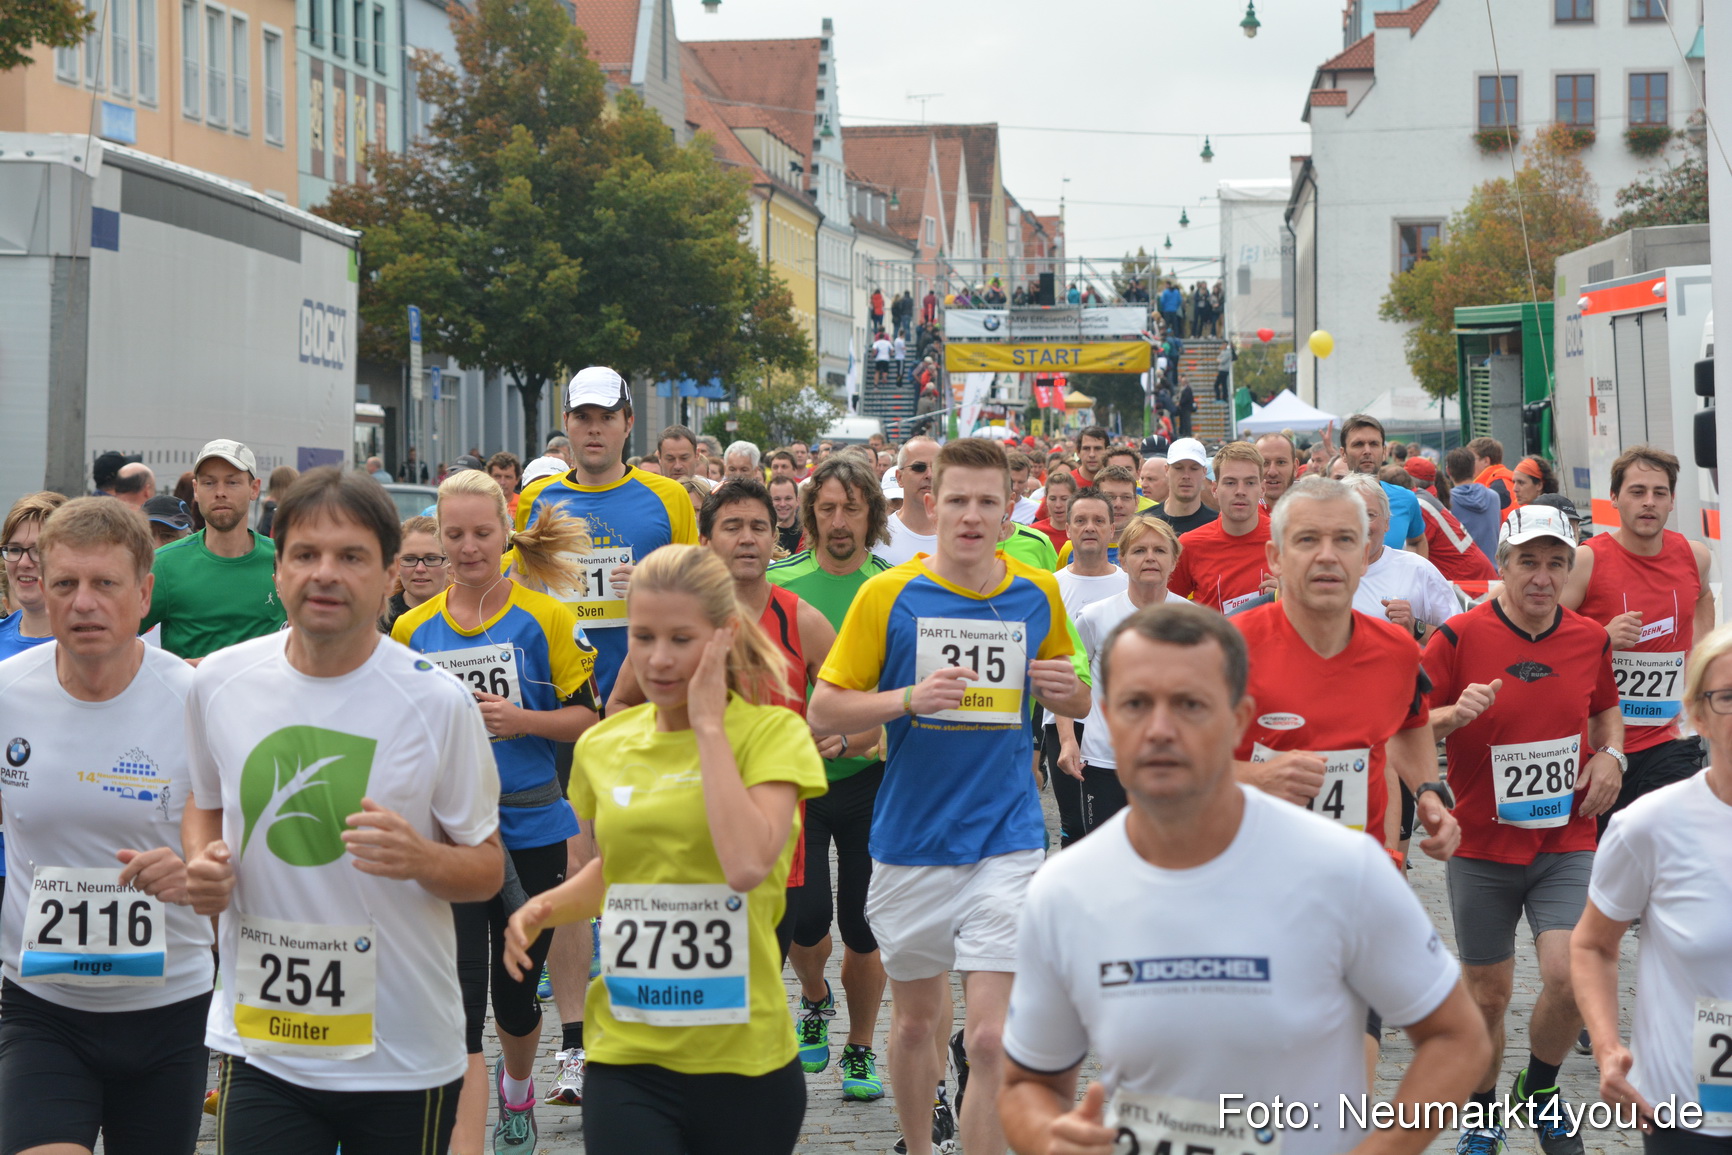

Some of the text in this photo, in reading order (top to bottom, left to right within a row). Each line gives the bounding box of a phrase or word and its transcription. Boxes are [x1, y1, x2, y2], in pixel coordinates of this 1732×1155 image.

[1030, 314, 1109, 324] EfficientDyamics
[299, 299, 346, 370] BOCK
[1012, 348, 1083, 366] START
[577, 605, 604, 617] Sven
[920, 628, 1008, 641] PARTL Neumarkt
[1641, 625, 1662, 637] DEHN
[450, 655, 496, 669] Neumarkt
[941, 644, 1005, 683] 315
[1612, 658, 1673, 667] ARTL Neumarkt
[1613, 669, 1678, 698] 2227
[1623, 703, 1662, 715] Florian
[1494, 747, 1570, 763] PARTL Neumarkt
[1, 767, 30, 781] PARTL
[1325, 762, 1349, 773] arkt
[77, 771, 100, 784] 14.
[1504, 758, 1575, 798] 2288
[1529, 801, 1562, 817] Josef
[34, 879, 141, 893] PARTL Neumark
[608, 898, 719, 911] PARTL Neumarkt
[38, 899, 153, 947] 2116
[240, 926, 348, 951] PARTL Neumarkt
[614, 919, 732, 970] 2733
[73, 960, 112, 975] Inge
[260, 953, 345, 1007] 254
[637, 985, 704, 1005] Nadine
[269, 1016, 330, 1040] Günter
